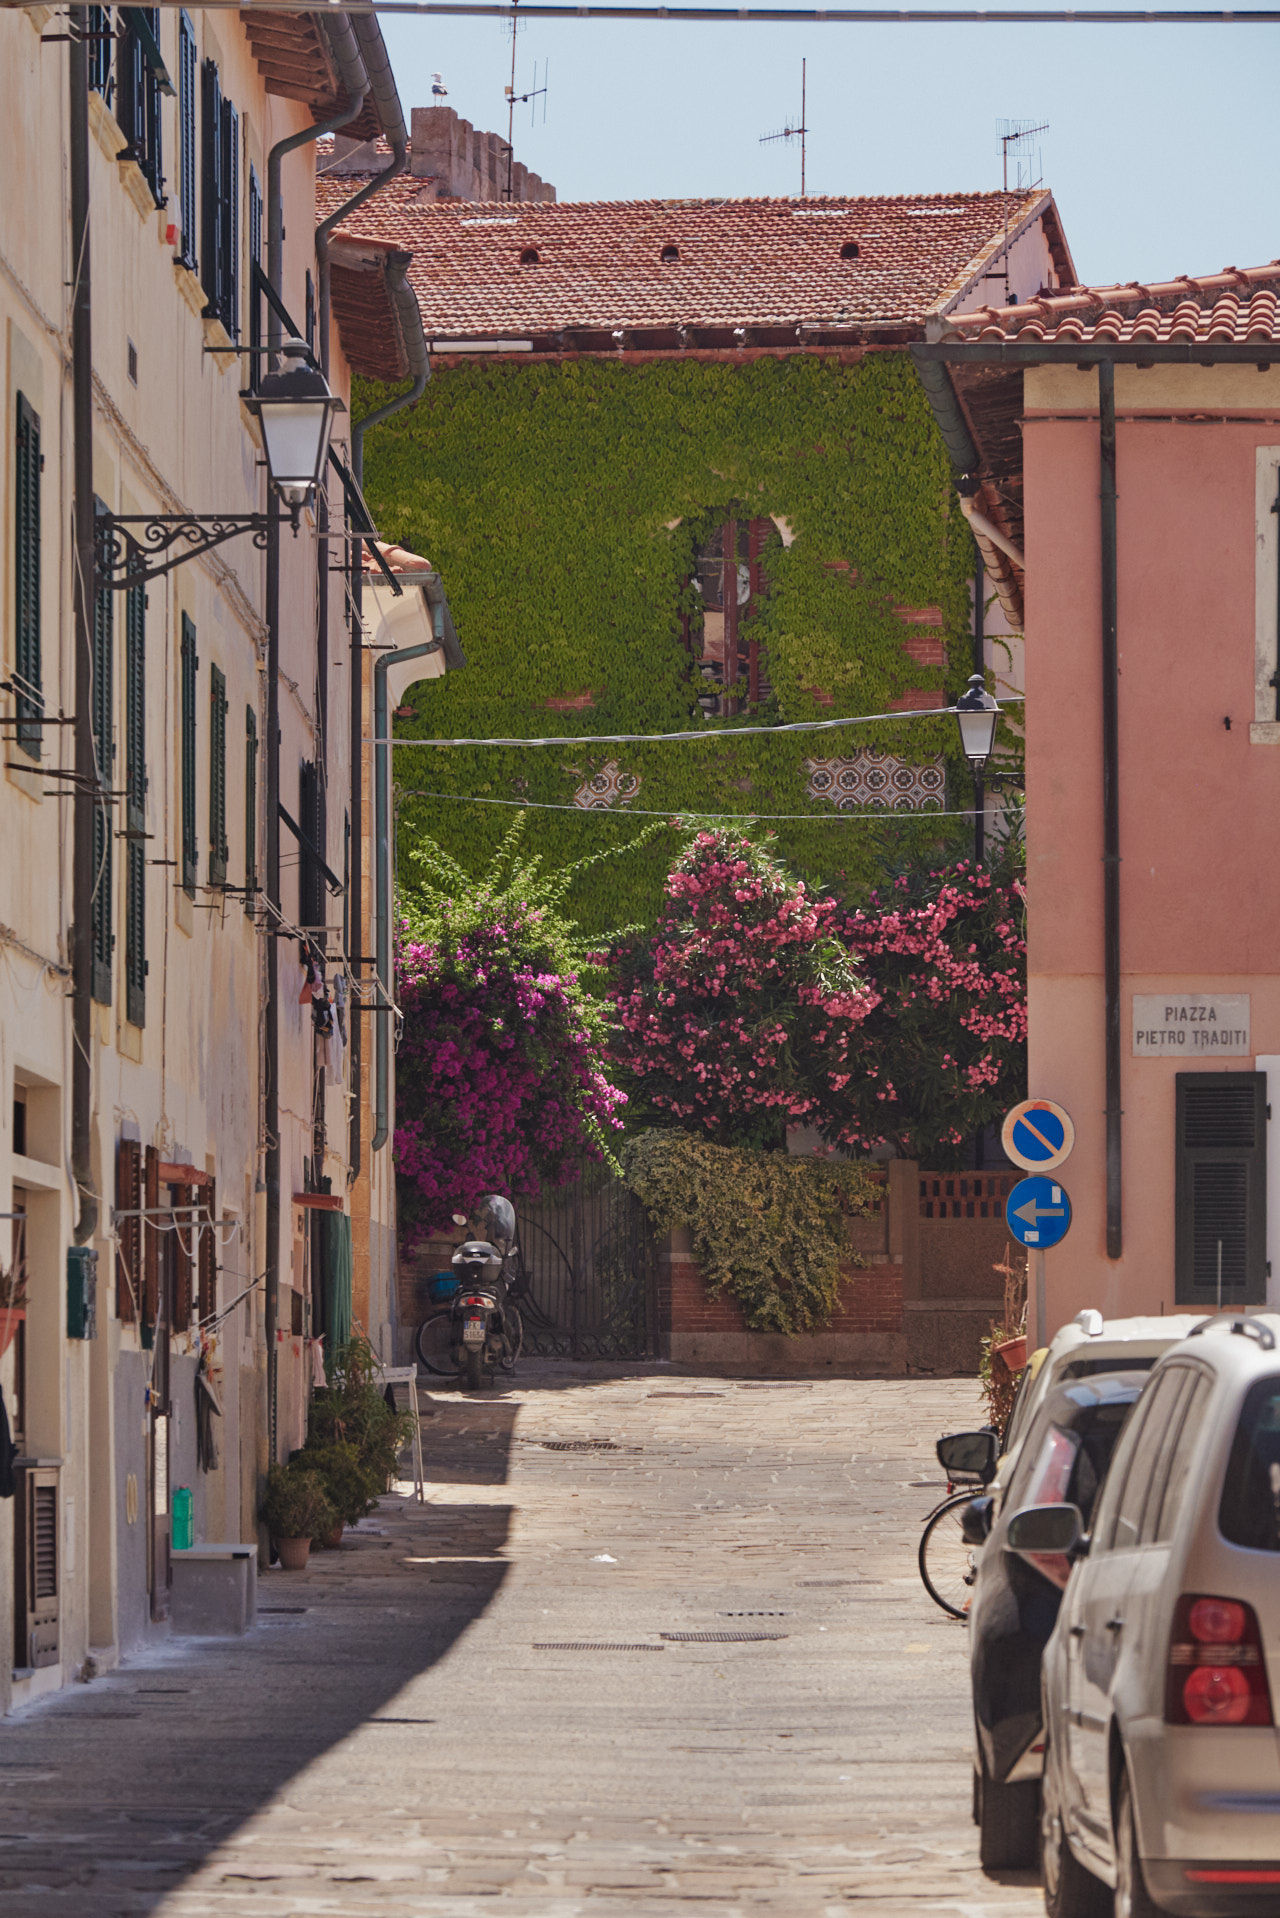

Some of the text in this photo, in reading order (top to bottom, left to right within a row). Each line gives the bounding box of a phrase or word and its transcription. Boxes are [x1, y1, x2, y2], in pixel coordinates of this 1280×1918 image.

[1165, 1006, 1217, 1021] PIAZZA
[1136, 1030, 1247, 1045] PIETRO TRADITI
